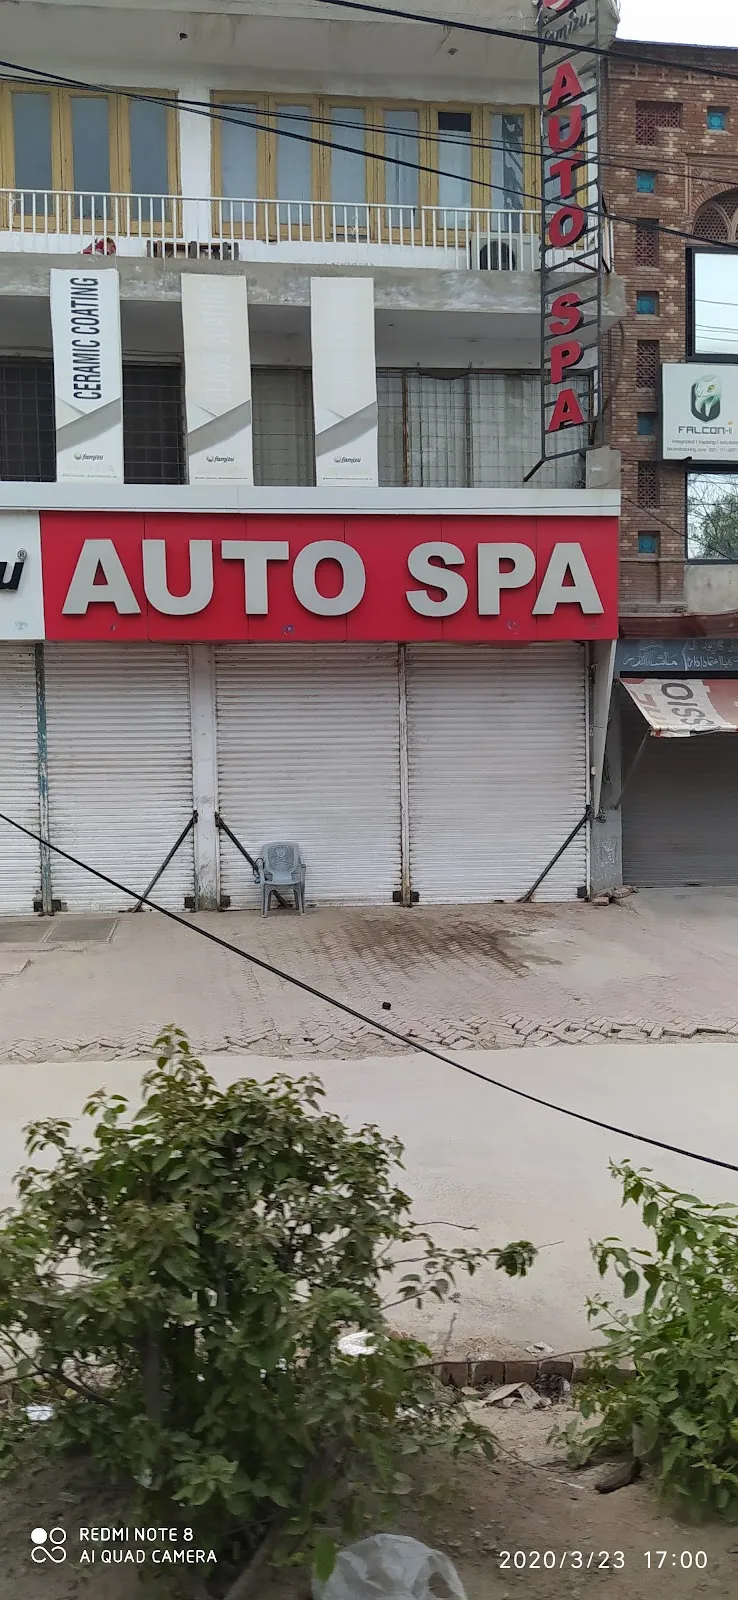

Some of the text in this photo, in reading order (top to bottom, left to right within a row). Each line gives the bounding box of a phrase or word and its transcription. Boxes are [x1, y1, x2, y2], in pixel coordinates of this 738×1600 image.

[547, 61, 587, 433] AUTO SPA
[70, 277, 102, 400] CERAMIC COATING
[61, 538, 605, 618] AUTO SPA
